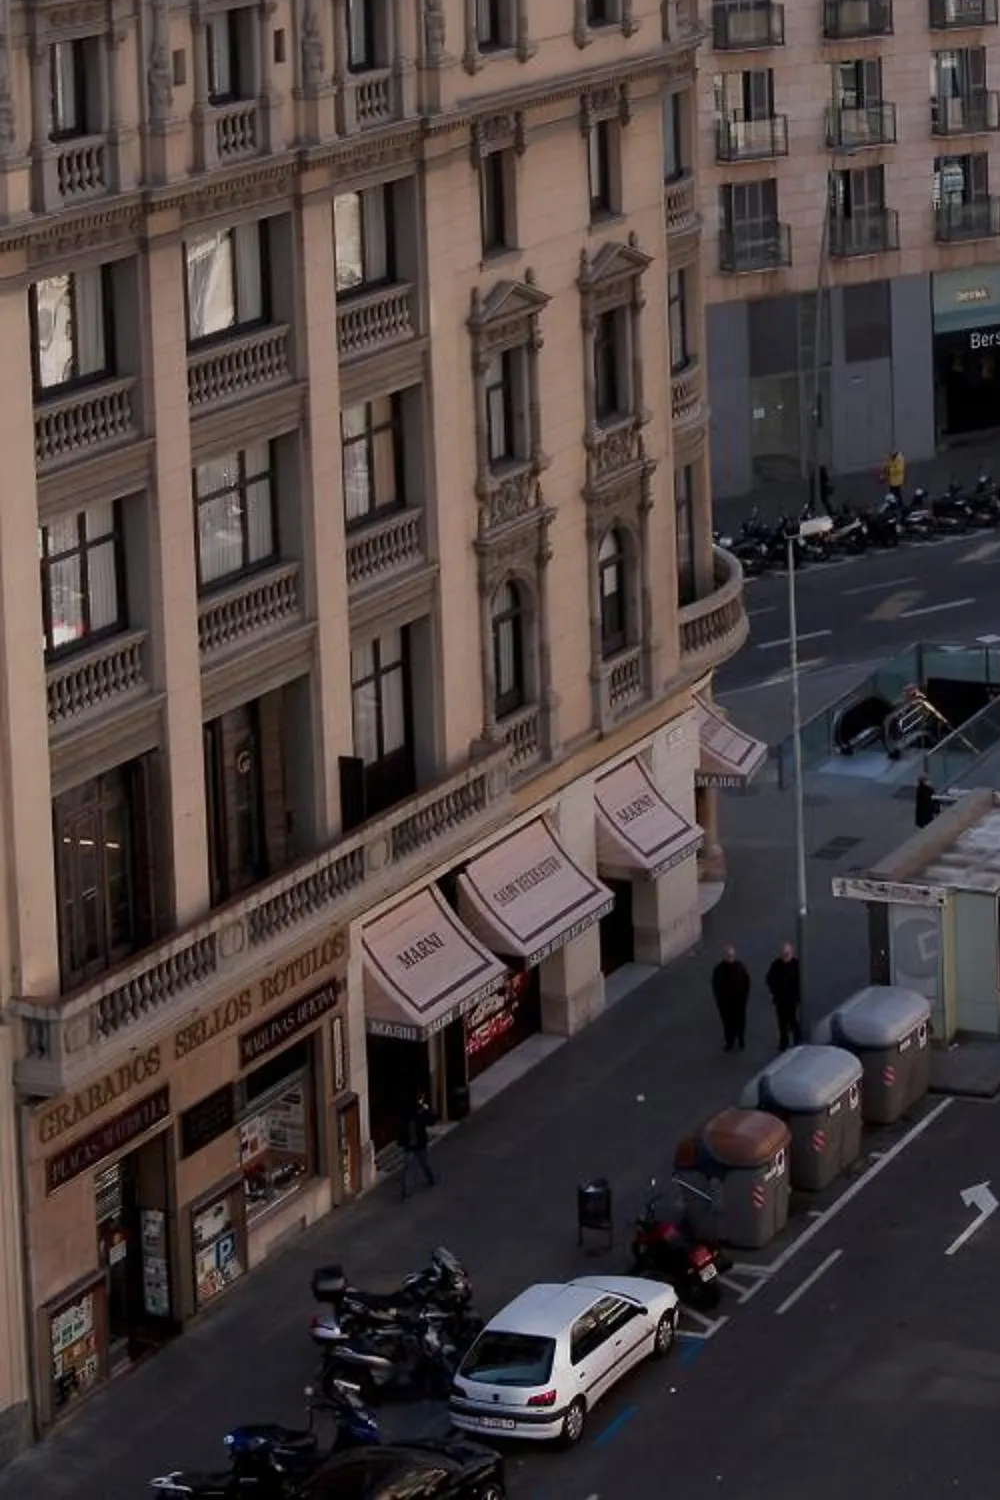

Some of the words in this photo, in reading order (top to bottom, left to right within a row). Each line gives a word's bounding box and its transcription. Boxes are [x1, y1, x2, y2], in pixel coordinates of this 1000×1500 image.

[615, 793, 656, 825] MARNI
[396, 931, 446, 970] MARNI
[39, 1051, 162, 1144] GRABADOS
[175, 988, 253, 1061] SELLOS
[259, 931, 347, 1006] ROTULOS
